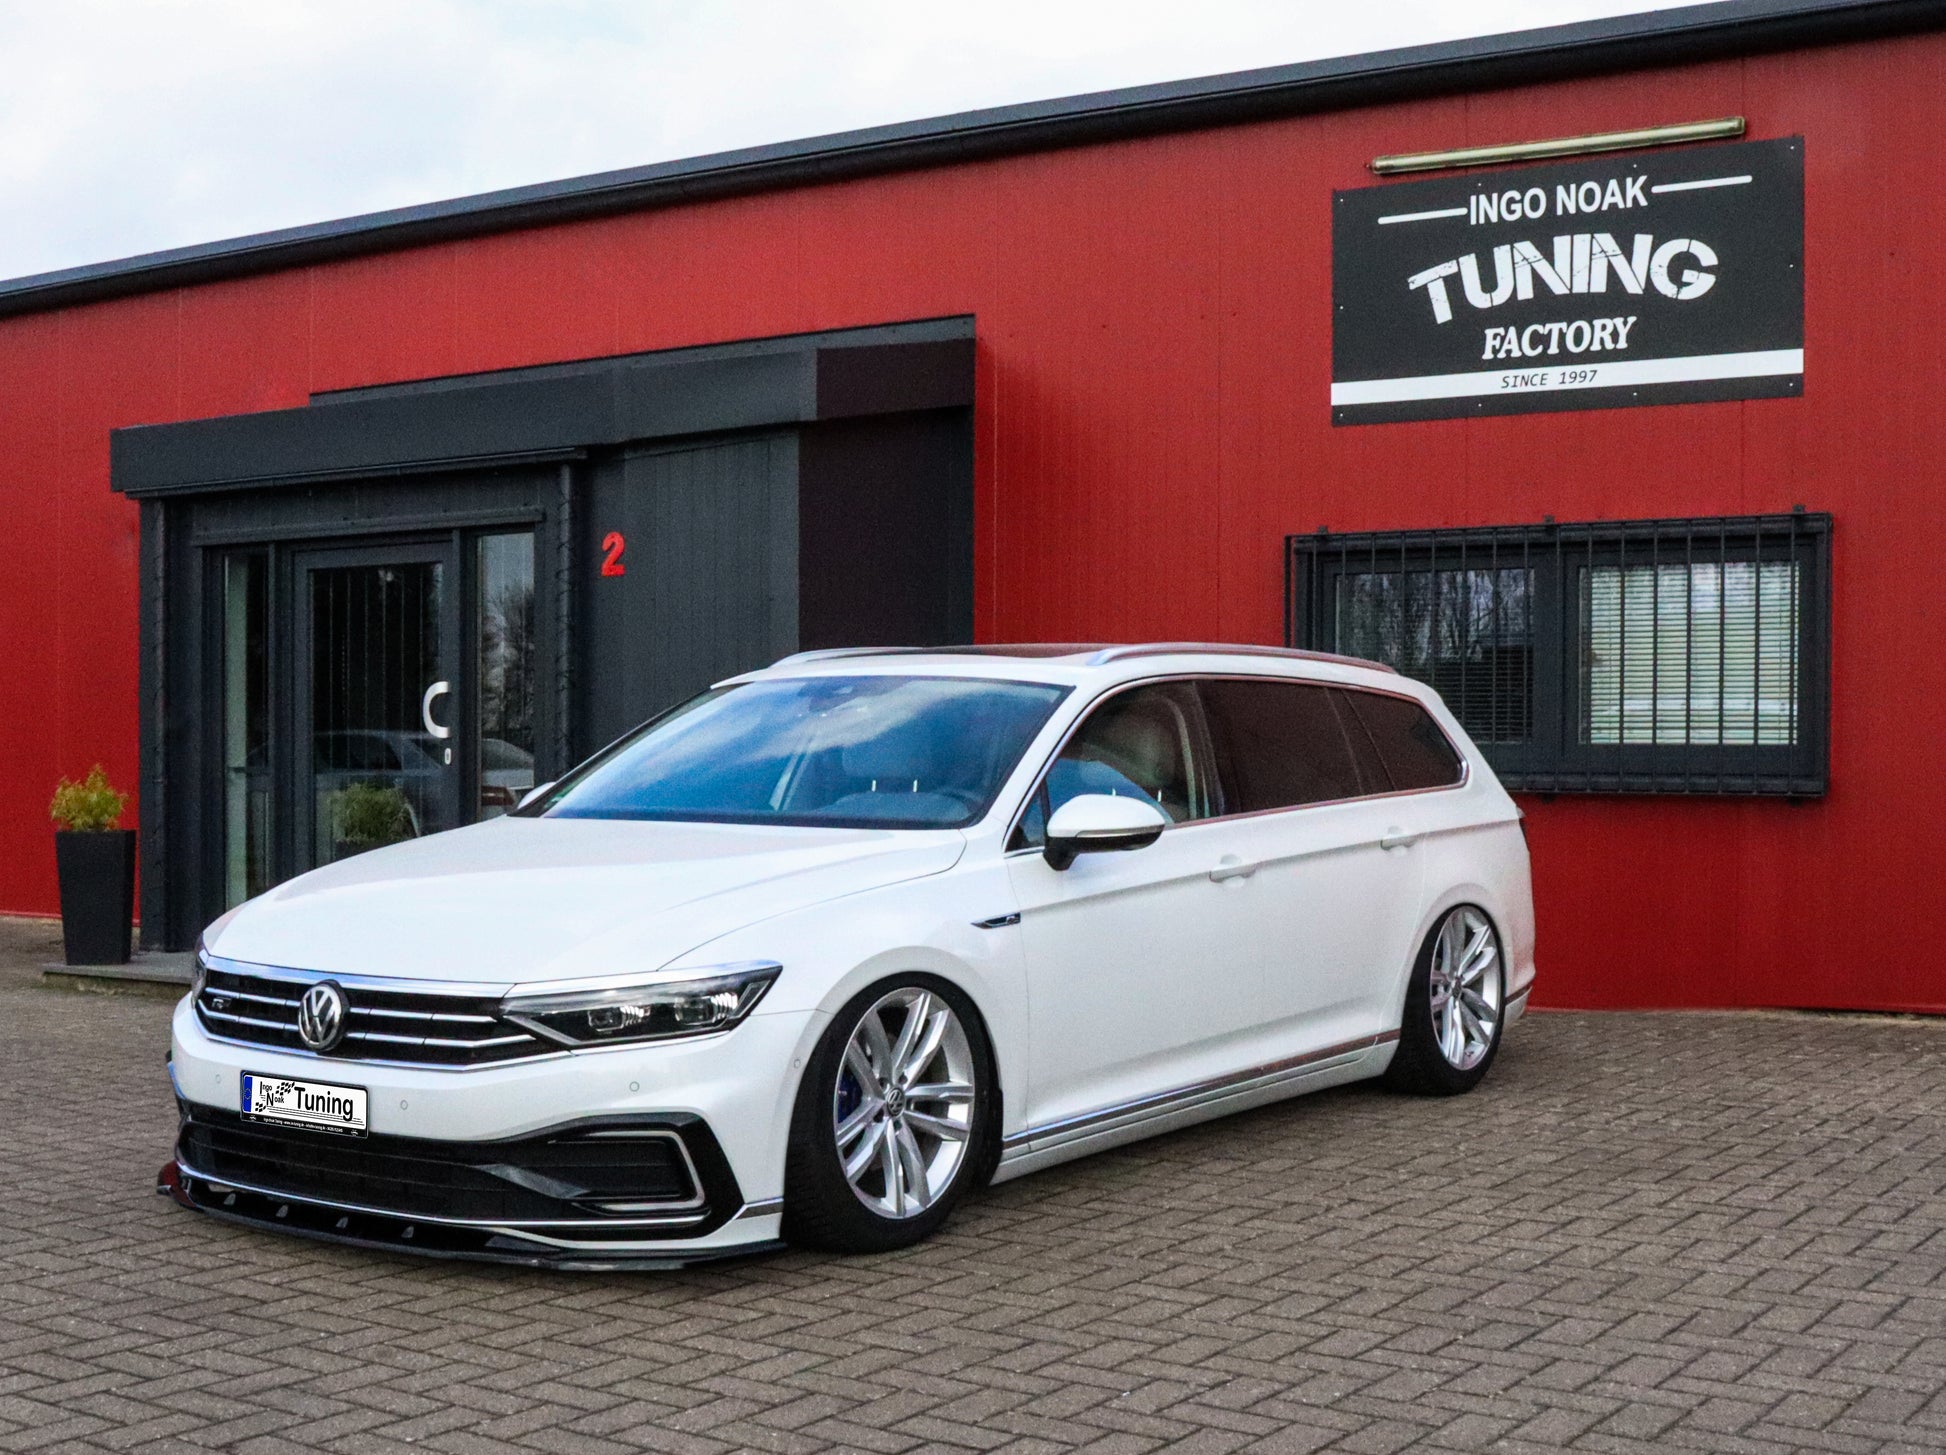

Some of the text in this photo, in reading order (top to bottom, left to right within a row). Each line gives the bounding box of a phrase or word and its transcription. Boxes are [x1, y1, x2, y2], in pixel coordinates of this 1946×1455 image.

[1469, 175, 1649, 225] INGO NOAK
[1407, 233, 1719, 325] TUNING
[1481, 316, 1637, 360] FACTORY
[1500, 369, 1598, 390] SINCE 1997
[601, 531, 626, 577] 2
[259, 1081, 273, 1094] Ingo
[266, 1092, 285, 1106] Noak
[294, 1086, 354, 1121] Tuning
